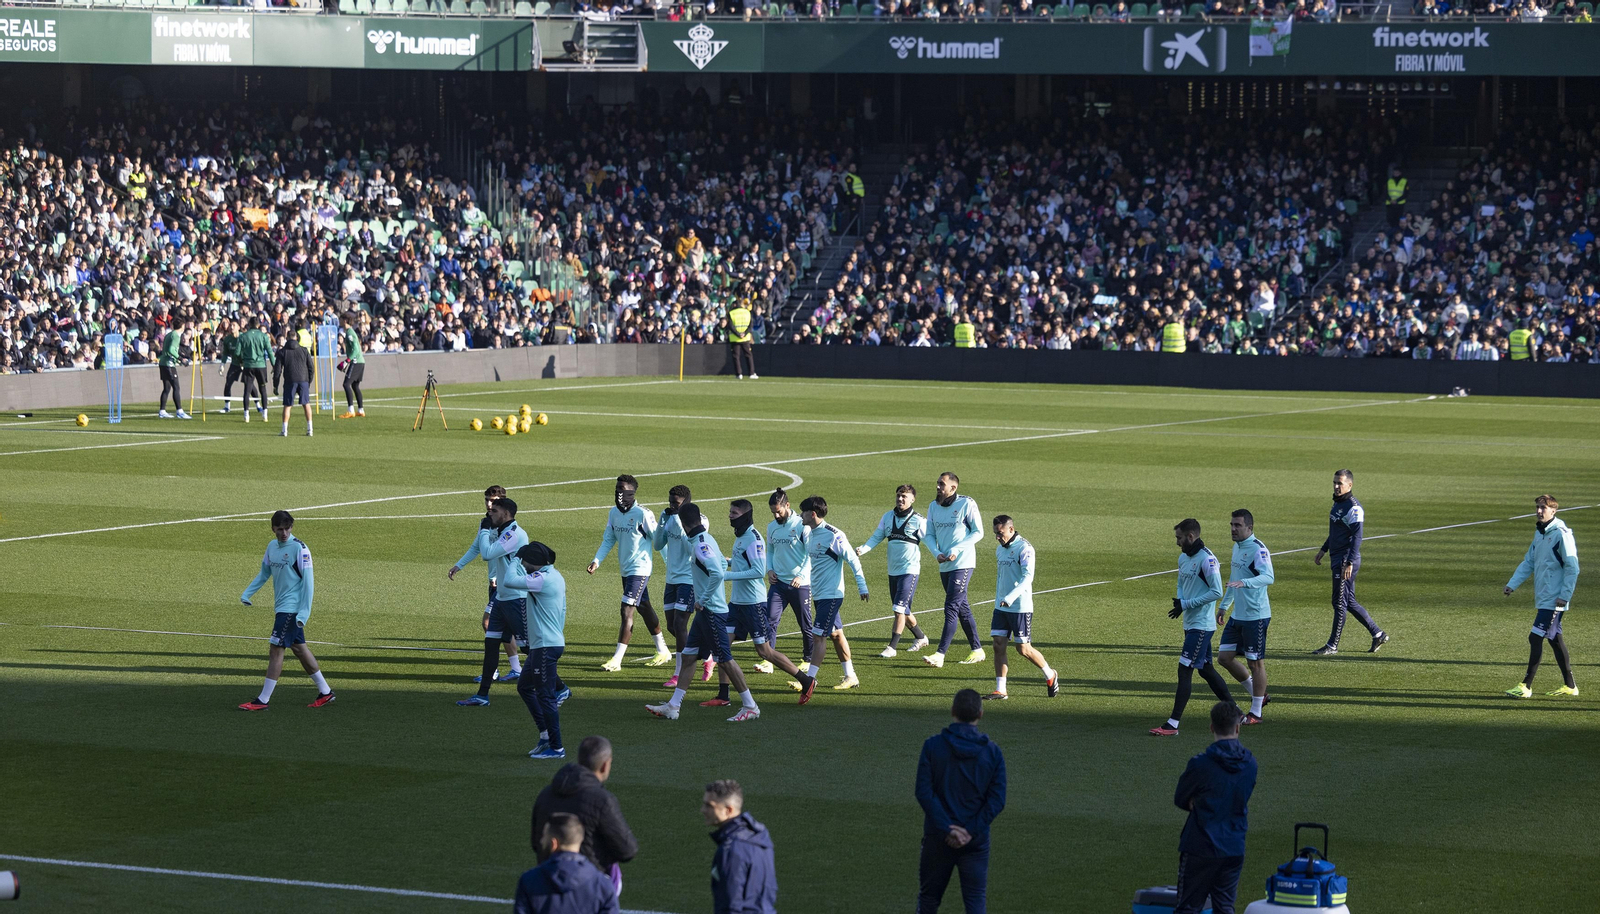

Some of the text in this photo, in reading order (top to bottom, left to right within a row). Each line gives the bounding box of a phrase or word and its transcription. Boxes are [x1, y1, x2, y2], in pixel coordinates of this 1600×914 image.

[0, 19, 56, 37] REALE
[154, 16, 251, 38] finetwork
[1373, 26, 1489, 47] finetwork
[173, 42, 232, 62] FIBRA Y MÓVIL
[395, 31, 476, 55] hummel
[917, 37, 1000, 59] hummel
[1395, 51, 1466, 72] FIBRA Y MÓVIL
